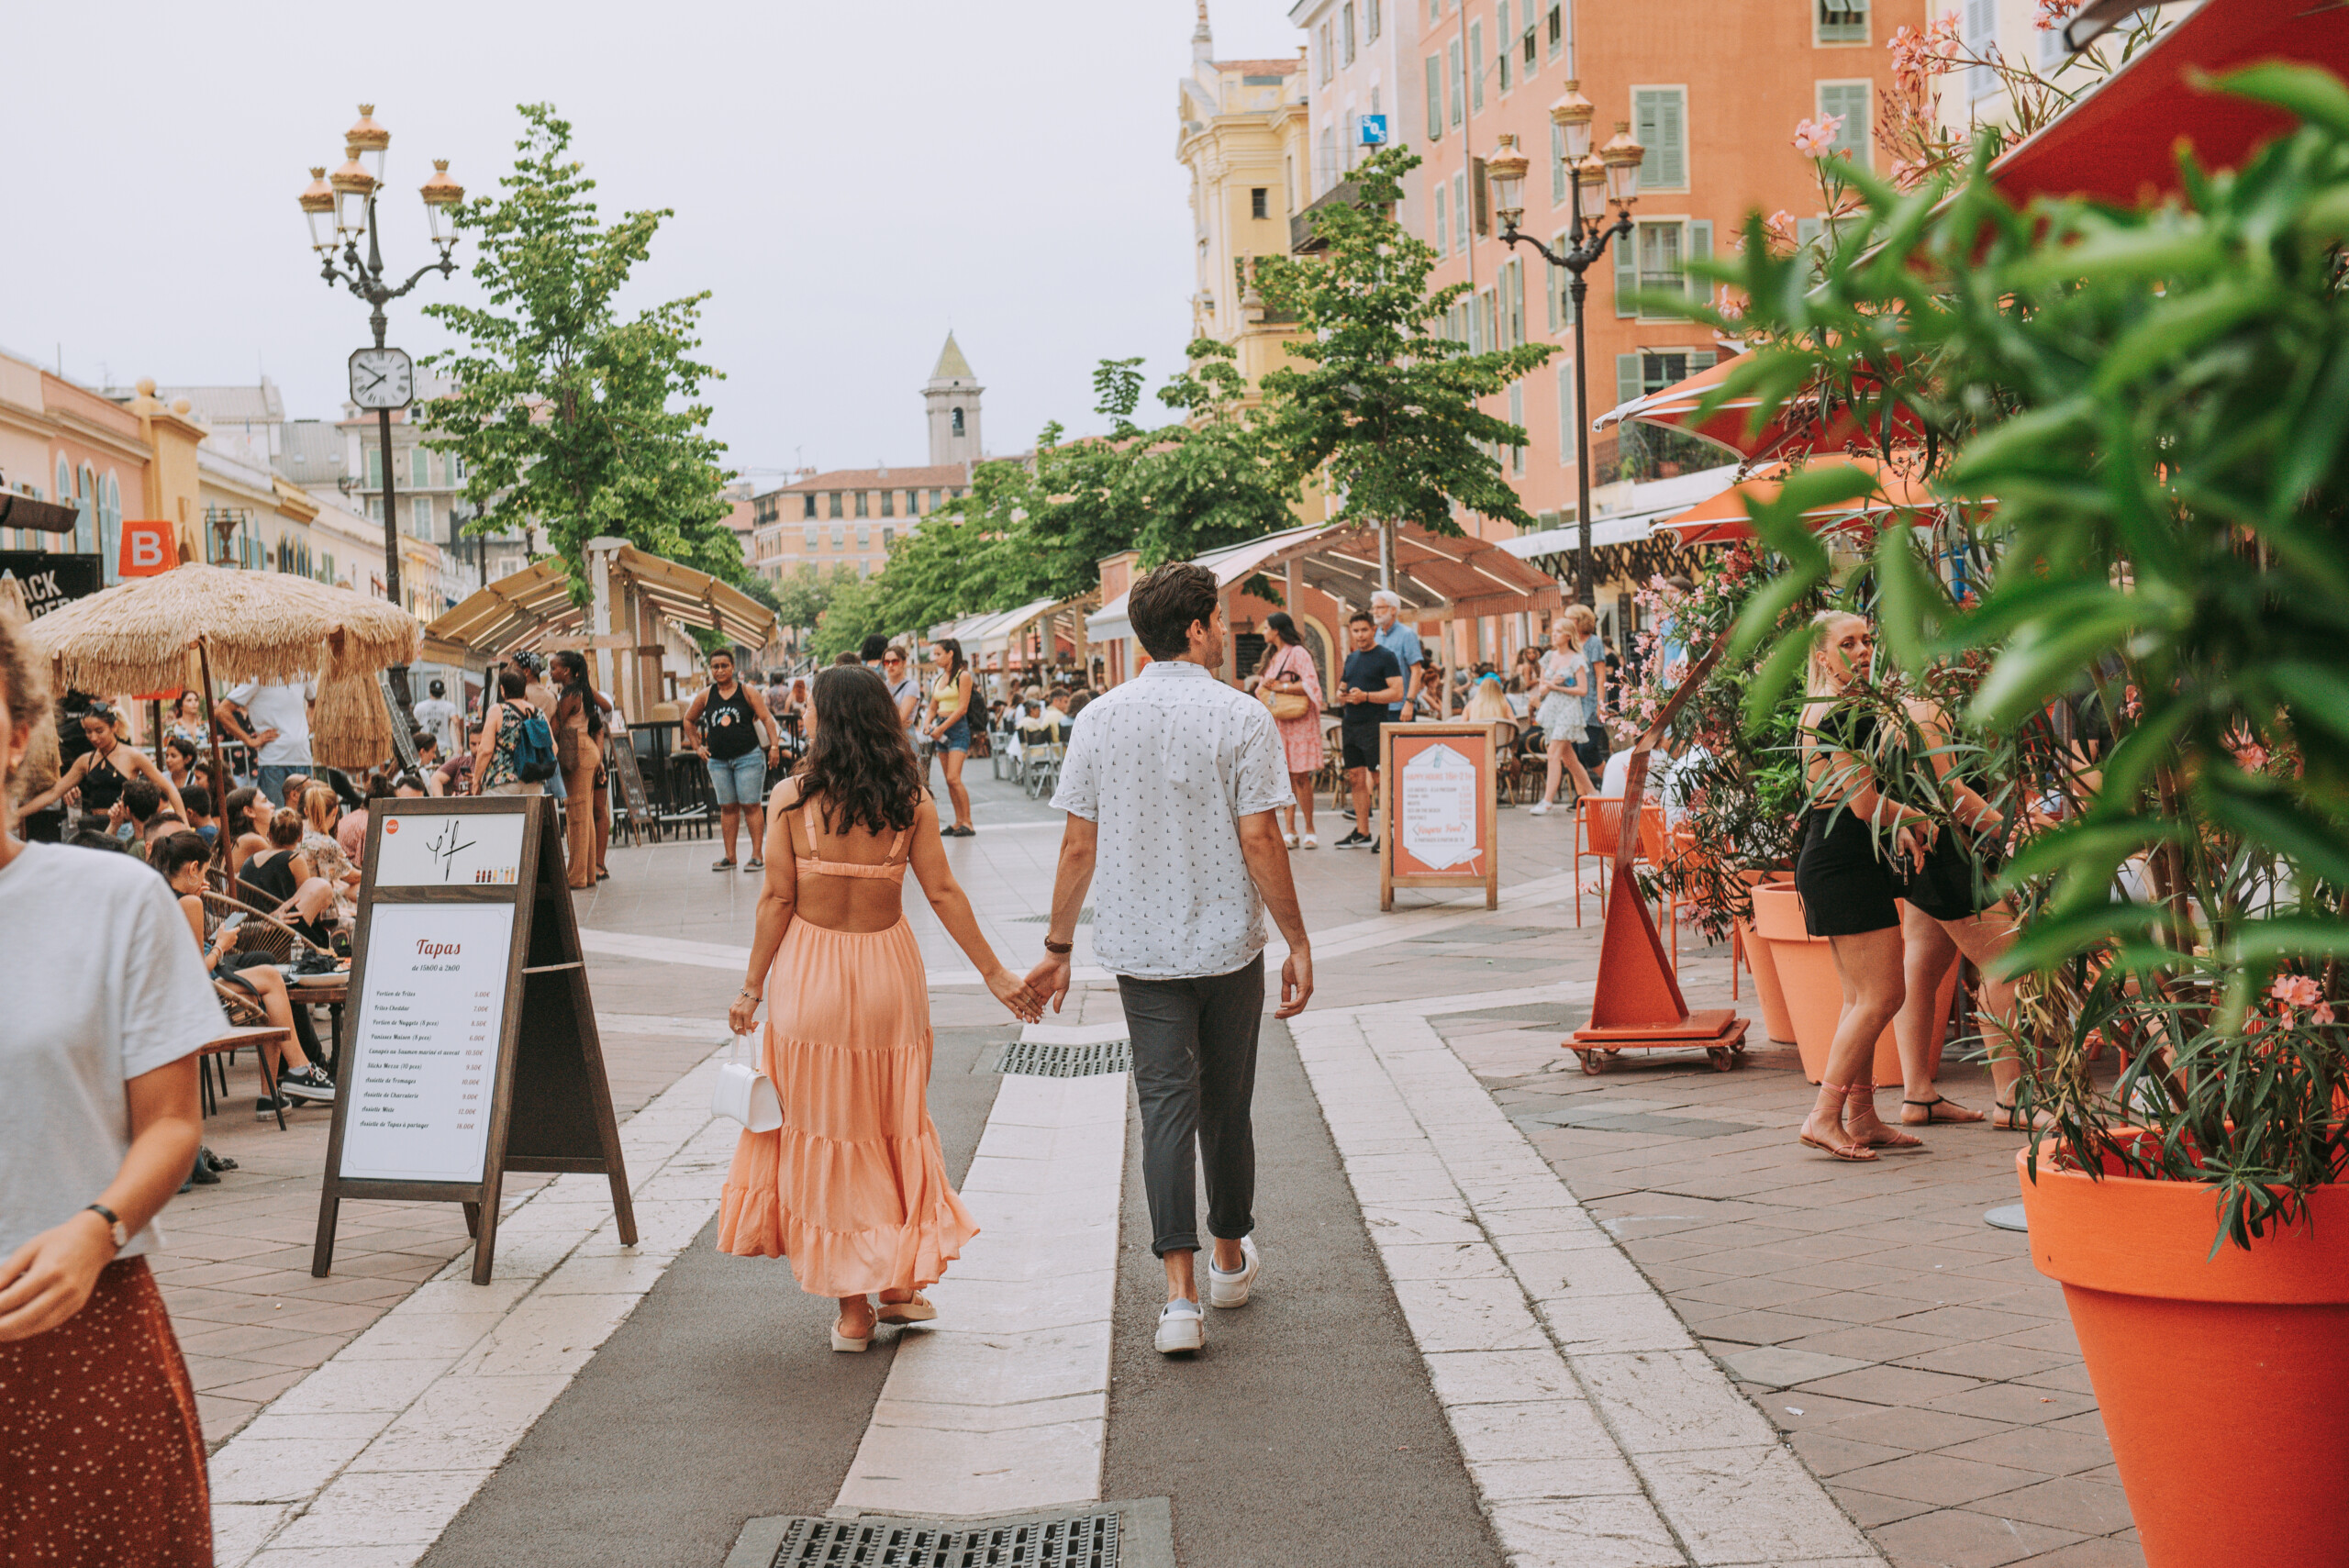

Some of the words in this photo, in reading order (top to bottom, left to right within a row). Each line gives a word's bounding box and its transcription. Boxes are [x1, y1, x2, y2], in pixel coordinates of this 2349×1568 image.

[1363, 115, 1386, 142] SOS
[131, 530, 163, 566] B
[17, 569, 63, 604] ACK
[416, 939, 462, 959] Tapas
